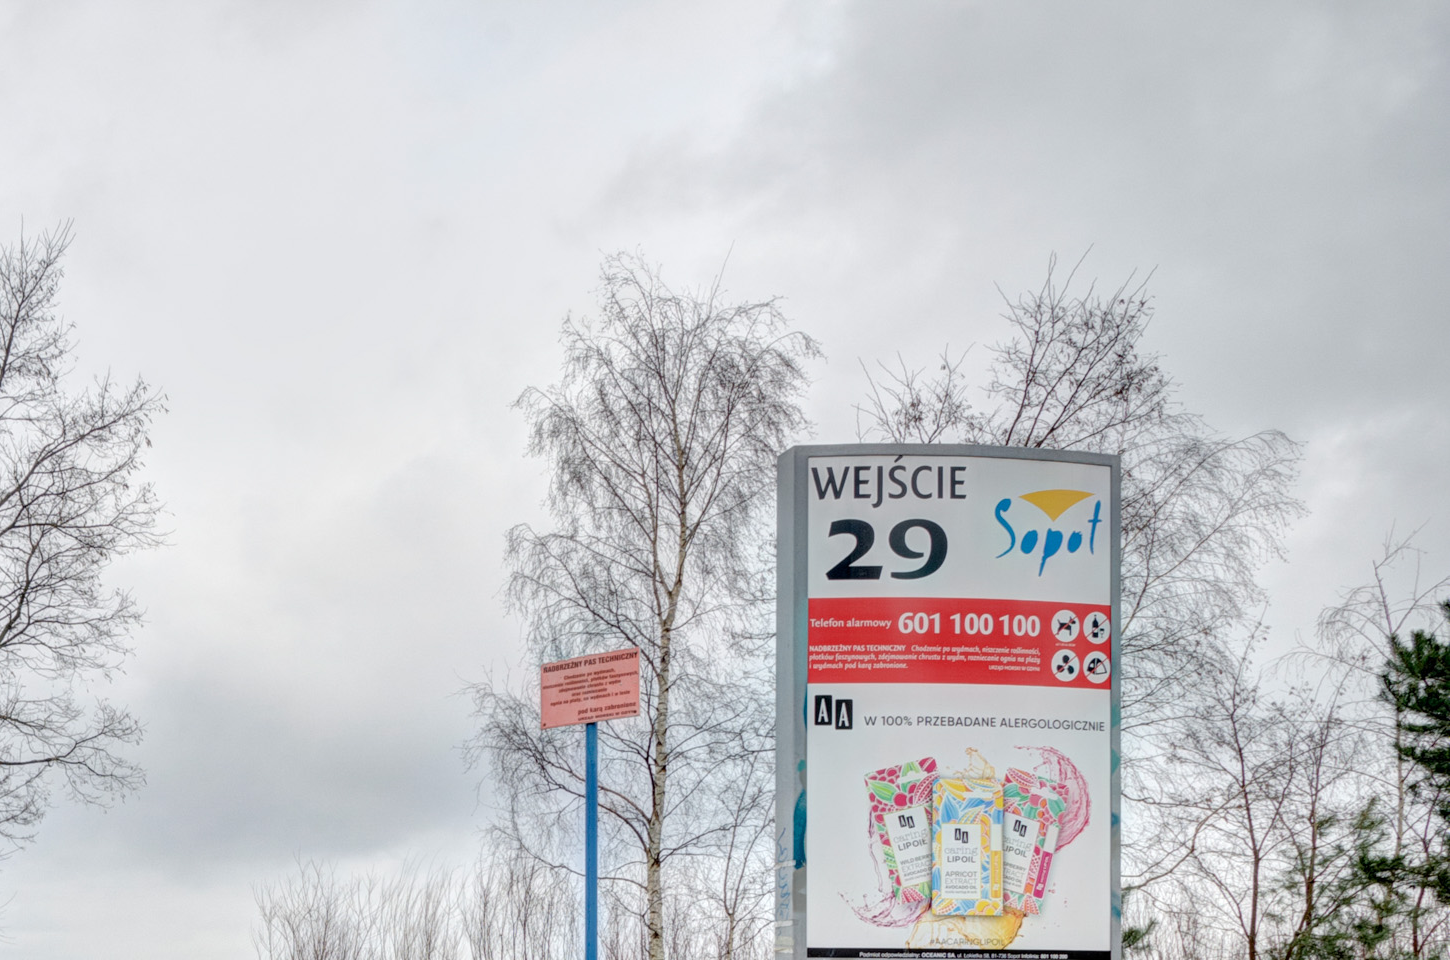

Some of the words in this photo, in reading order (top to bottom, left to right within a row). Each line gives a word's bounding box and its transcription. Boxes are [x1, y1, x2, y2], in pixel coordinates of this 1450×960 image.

[811, 455, 967, 508] WEJŚCIE
[994, 498, 1102, 577] Sopot
[826, 518, 948, 580] 29
[810, 618, 844, 628] Telefon
[846, 618, 892, 630] alarmowy
[898, 612, 941, 634] 601
[950, 613, 994, 635] 100
[999, 614, 1040, 637] 100
[584, 658, 596, 667] PAS
[598, 652, 638, 664] TECHNICZNY
[878, 653, 917, 661] zdejmowanie
[812, 662, 843, 670] wydmach
[578, 707, 588, 715] pod
[815, 696, 852, 729] AA
[864, 716, 877, 726] W
[880, 716, 913, 727] 100%
[917, 716, 997, 728] PRZEBADANE
[1000, 718, 1105, 732] ALERGOLOGICZNIE
[894, 828, 928, 843] caring
[944, 847, 978, 856] caring
[902, 861, 932, 873] EXTRAC
